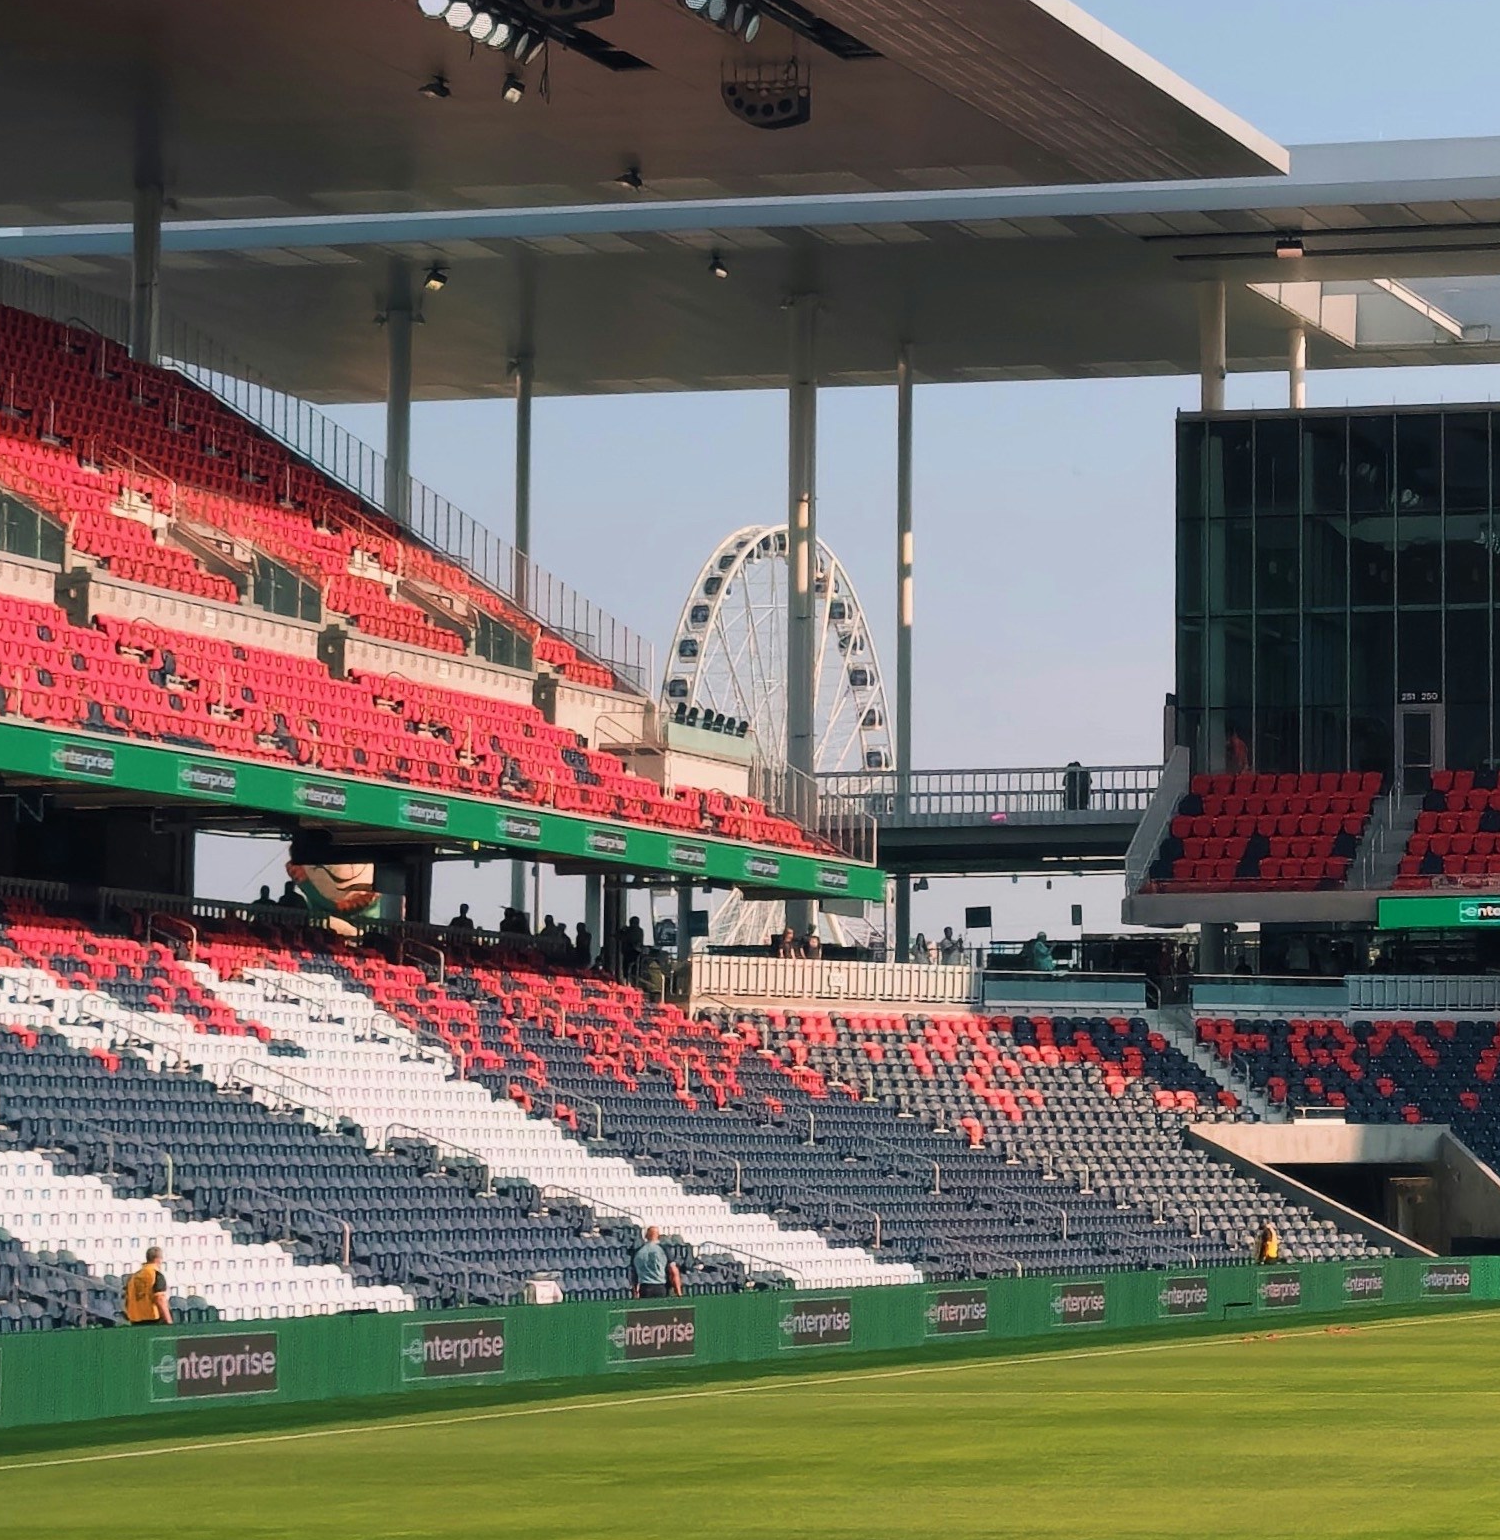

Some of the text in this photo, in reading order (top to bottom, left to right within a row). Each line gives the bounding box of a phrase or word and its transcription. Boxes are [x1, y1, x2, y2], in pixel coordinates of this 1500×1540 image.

[55, 748, 114, 770] enterprise
[181, 768, 236, 789] enterprise
[1053, 1290, 1105, 1317] enterprise
[1161, 1283, 1208, 1308] enterprise
[783, 1307, 850, 1339] enterprise
[928, 1297, 987, 1326] enterprise
[611, 1316, 695, 1350] enterprise
[409, 1329, 504, 1368] enterprise
[160, 1343, 276, 1386] enterprise
